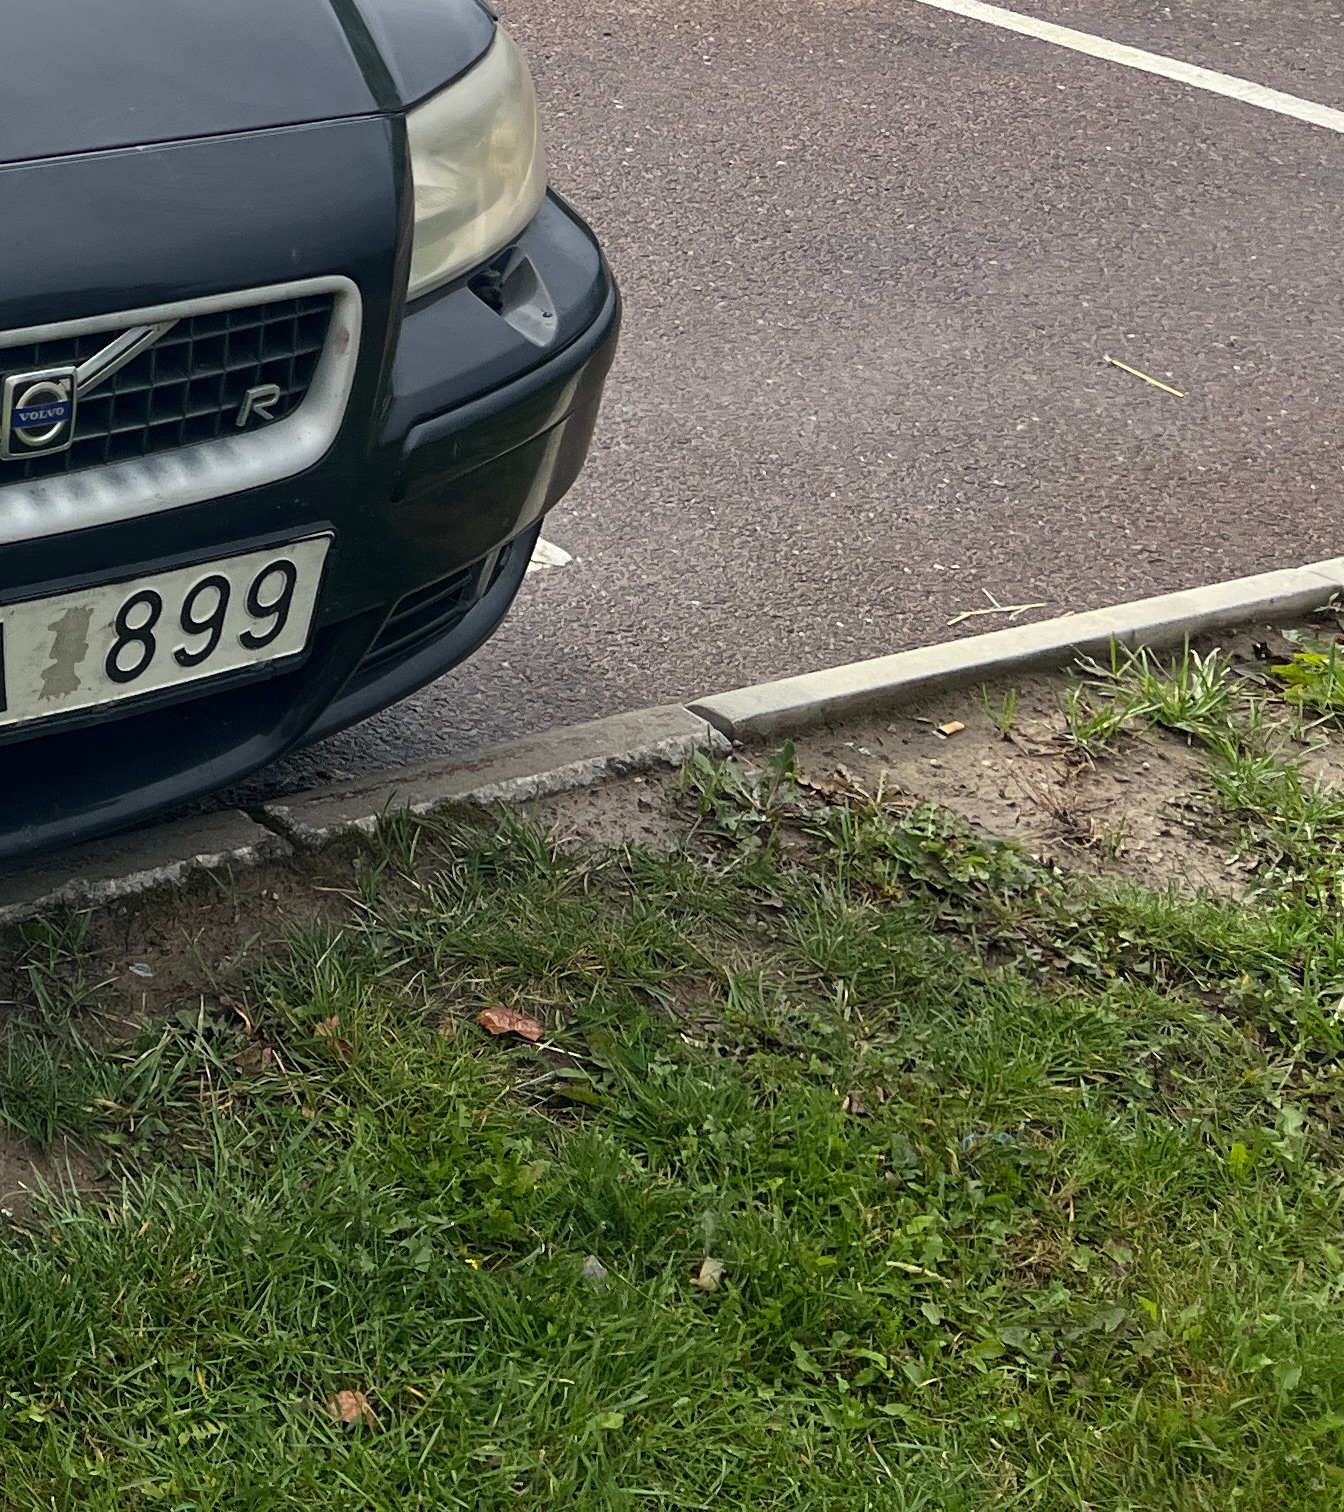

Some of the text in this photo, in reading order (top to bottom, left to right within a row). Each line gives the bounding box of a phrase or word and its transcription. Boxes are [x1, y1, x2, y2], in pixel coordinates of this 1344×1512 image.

[18, 407, 65, 422] VOLVO
[235, 383, 280, 427] R
[105, 558, 297, 685] 899
